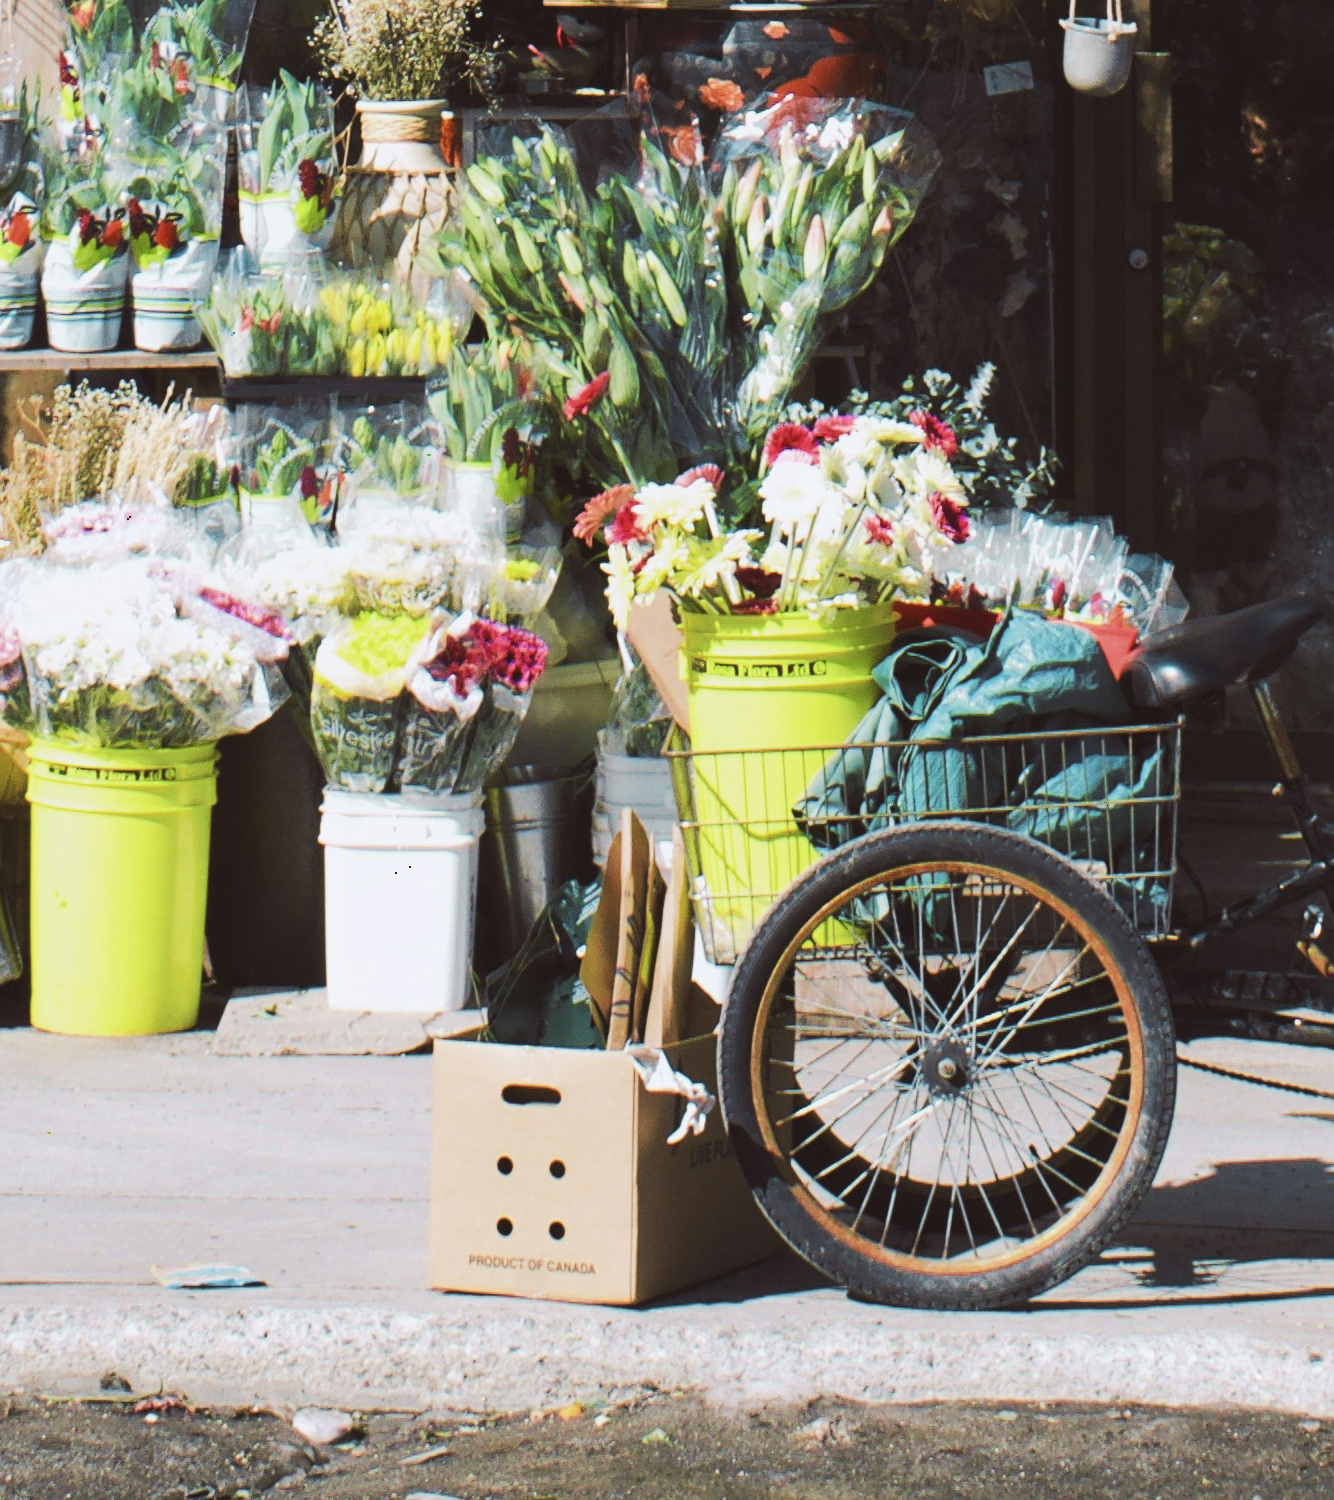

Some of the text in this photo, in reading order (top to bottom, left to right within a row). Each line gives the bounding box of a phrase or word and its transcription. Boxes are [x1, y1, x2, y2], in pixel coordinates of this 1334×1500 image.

[469, 1254, 596, 1275] PRODUCT OF CANADA
